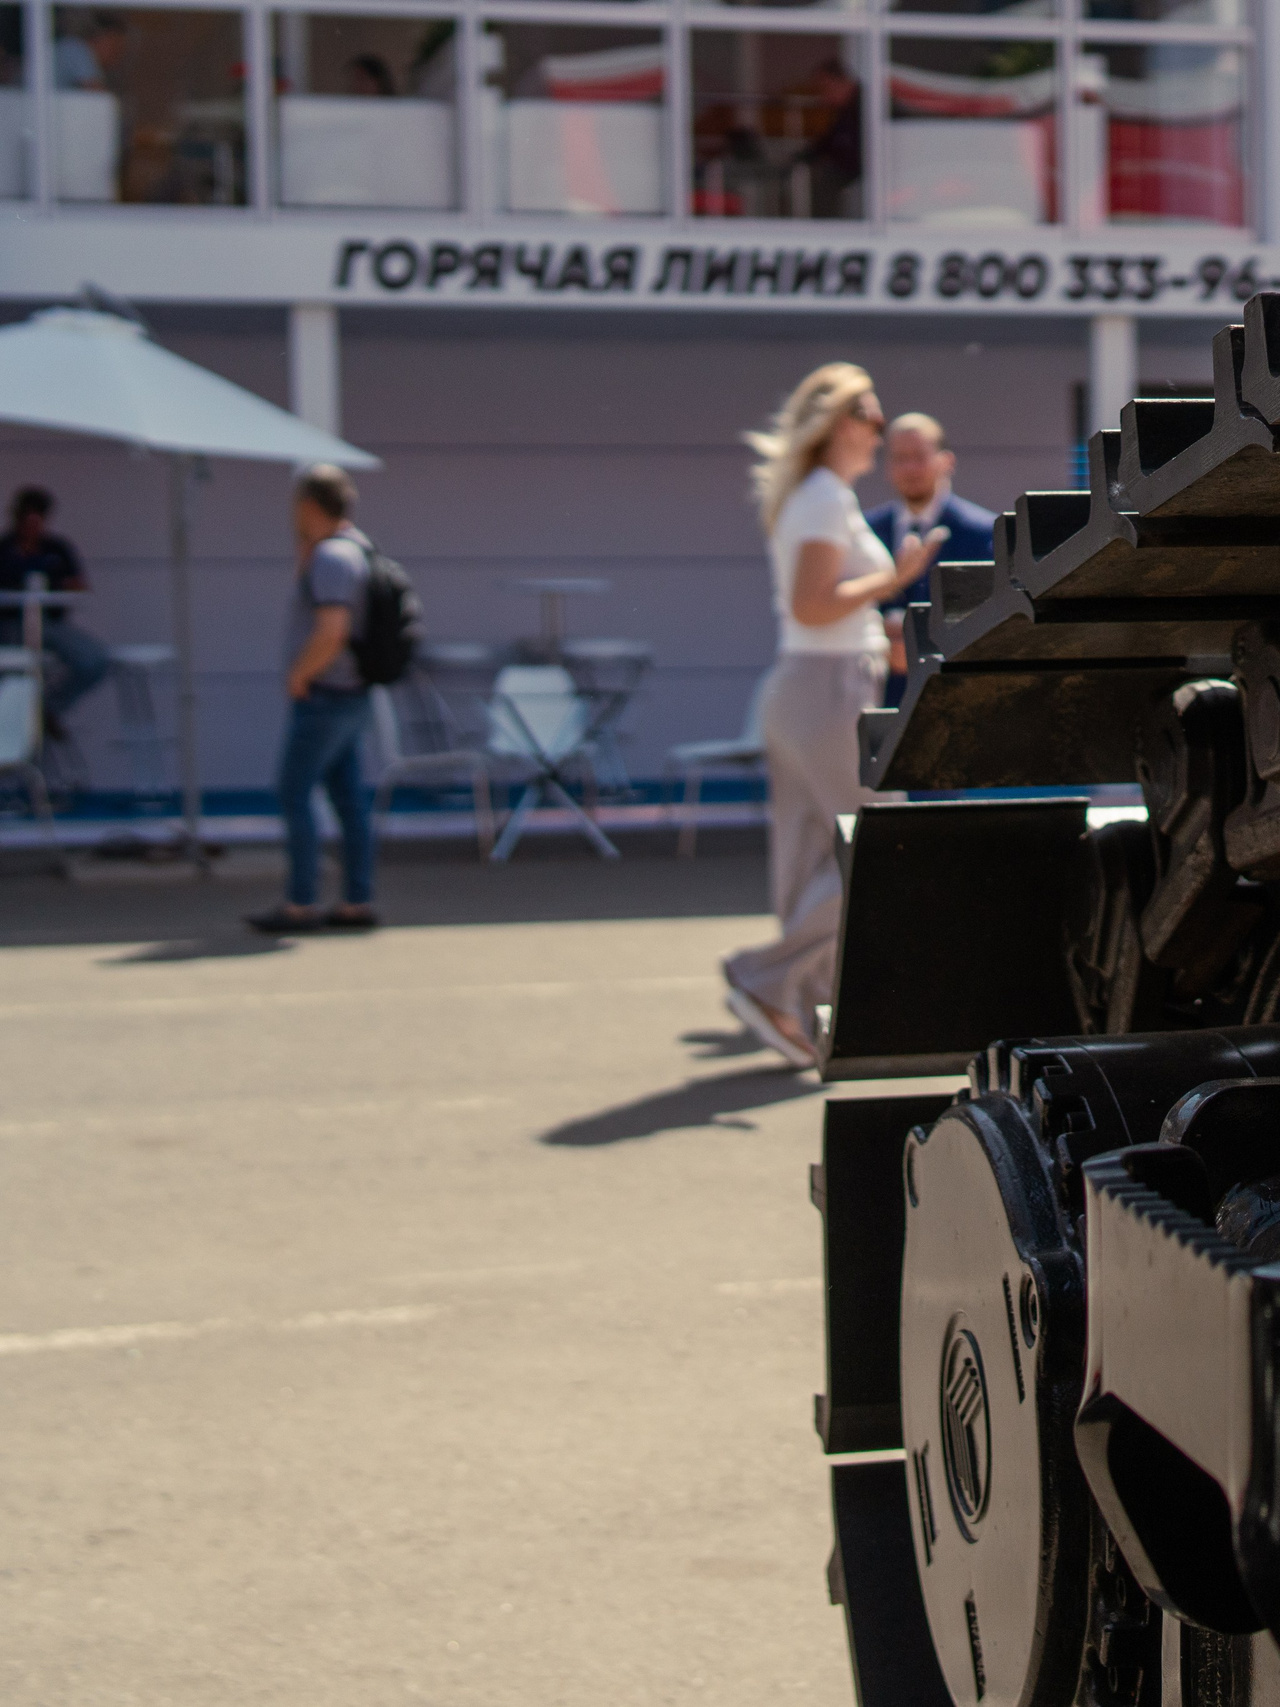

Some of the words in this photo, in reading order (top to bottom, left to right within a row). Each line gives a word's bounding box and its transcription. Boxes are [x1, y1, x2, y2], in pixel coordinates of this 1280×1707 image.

[336, 240, 638, 292] ГОРЯЧАЯ
[654, 246, 869, 295] ЛИНИЯ
[888, 251, 920, 299] 8
[936, 252, 1047, 299] 800
